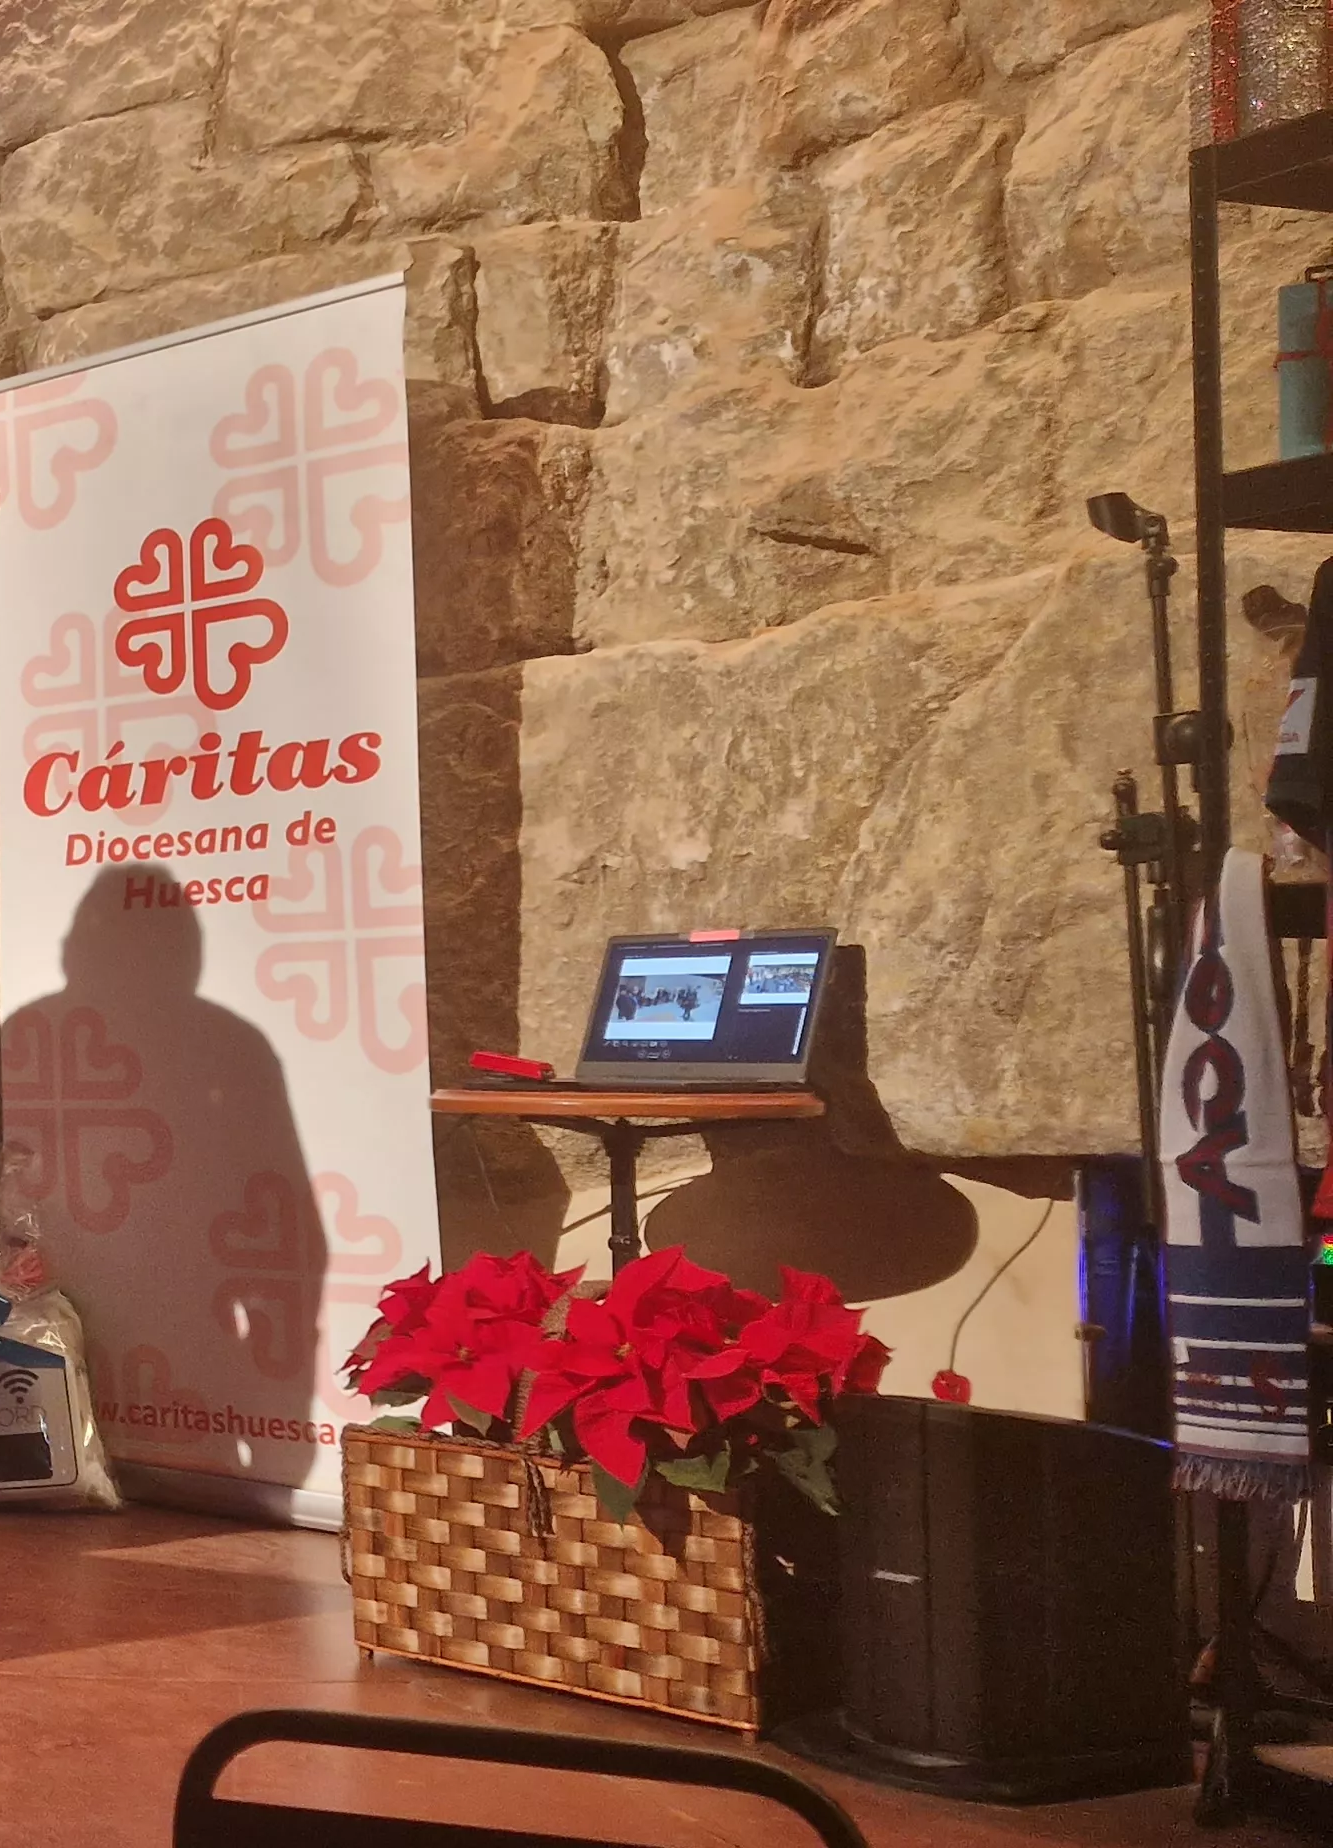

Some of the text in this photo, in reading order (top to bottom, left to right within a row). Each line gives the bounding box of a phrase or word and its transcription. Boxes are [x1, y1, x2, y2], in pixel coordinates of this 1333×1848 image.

[21, 729, 383, 818] Cáritas
[65, 809, 337, 866] Diocesana de
[123, 872, 270, 910] Huesca
